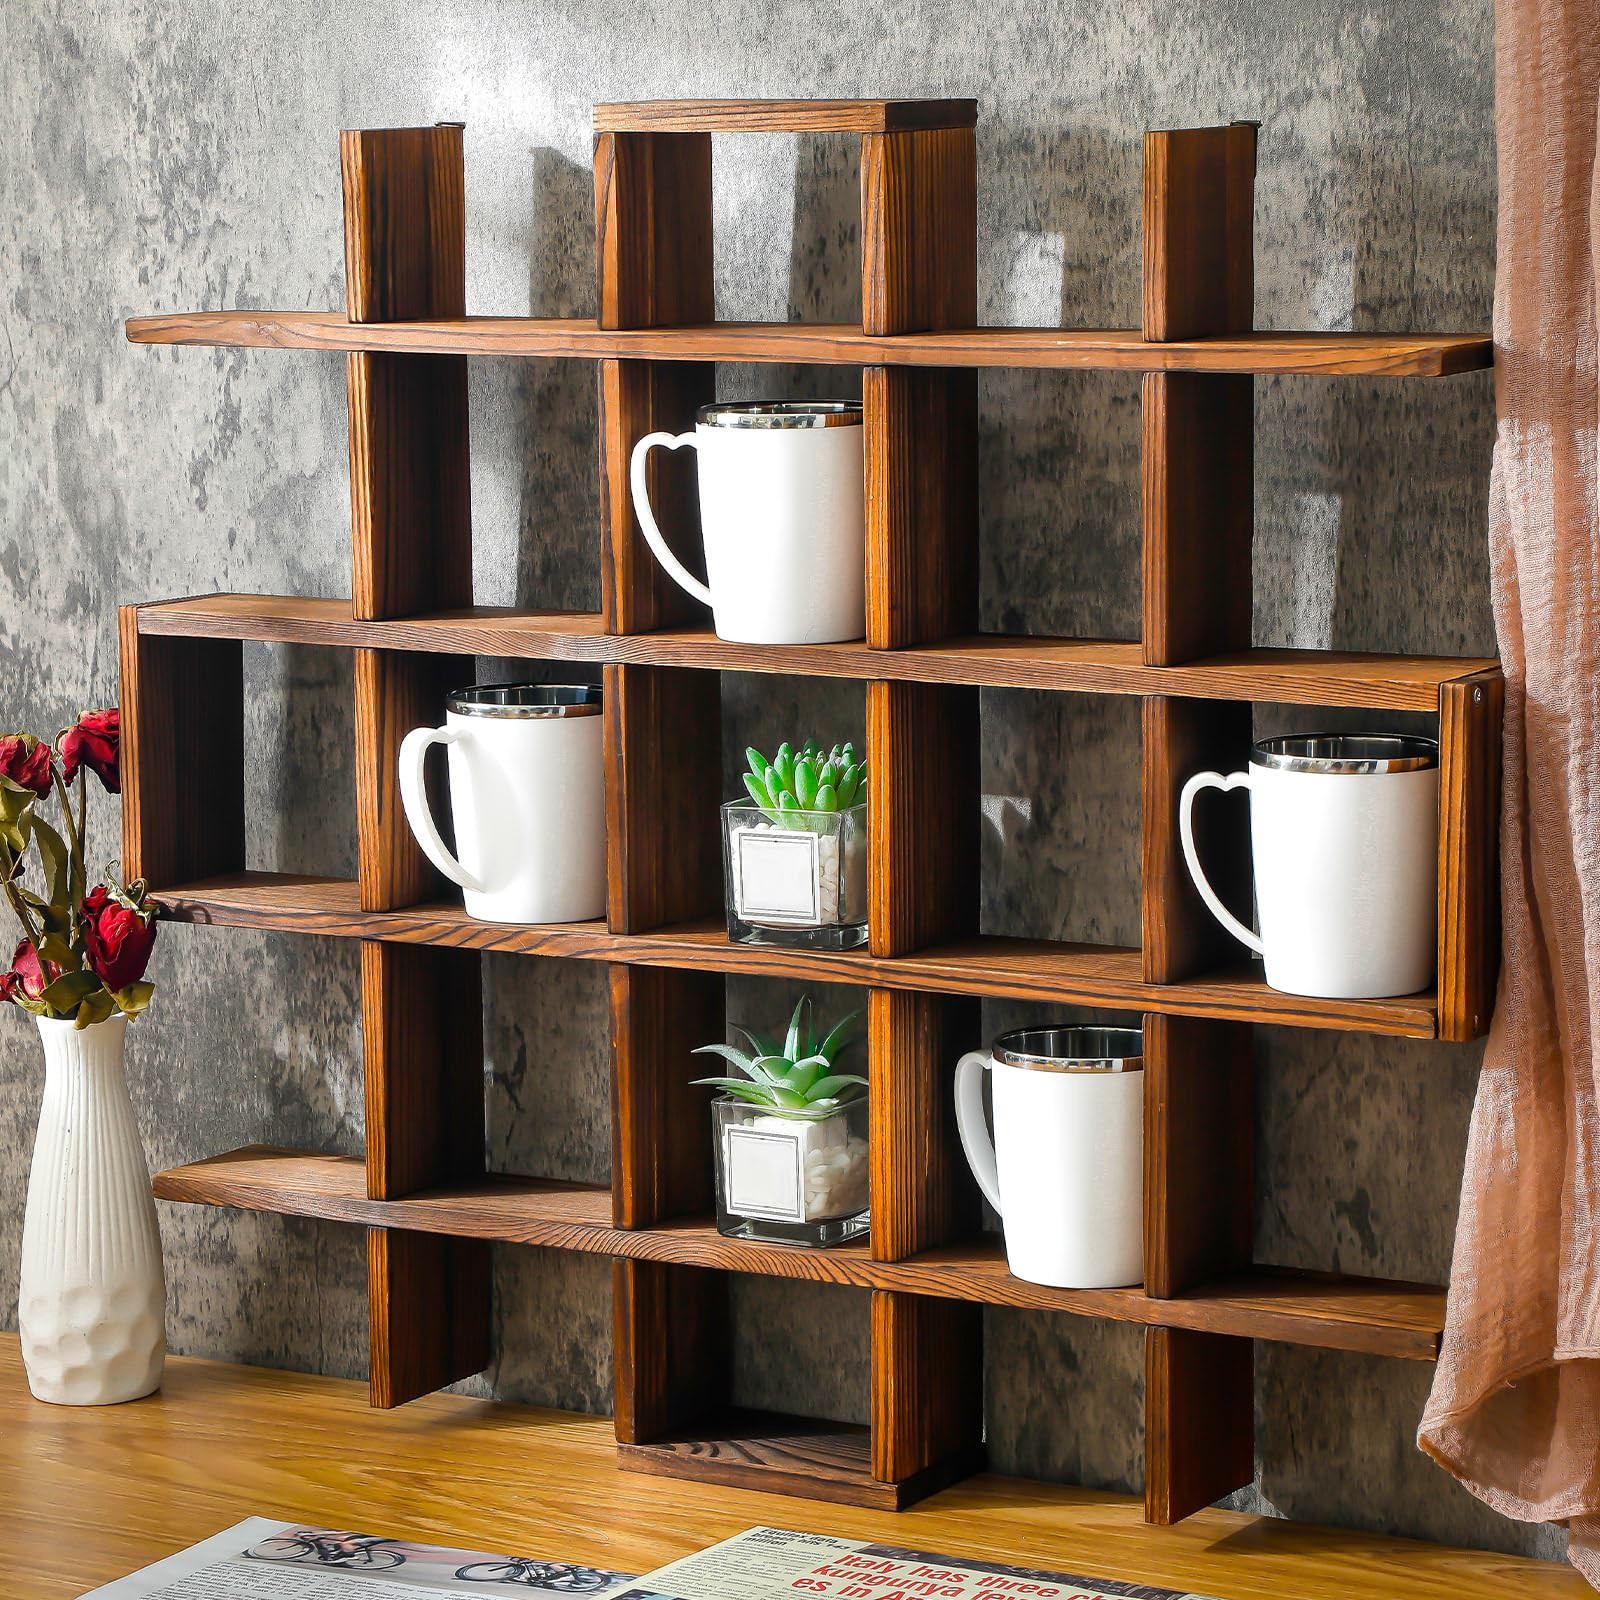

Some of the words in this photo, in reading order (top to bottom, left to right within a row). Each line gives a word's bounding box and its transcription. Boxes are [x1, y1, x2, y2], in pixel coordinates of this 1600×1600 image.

[791, 1578, 833, 1592] es
[837, 1583, 873, 1599] in
[811, 1565, 966, 1598] kungunya
[834, 1555, 906, 1574] Italy
[908, 1566, 970, 1583] has
[975, 1577, 1060, 1598] three
